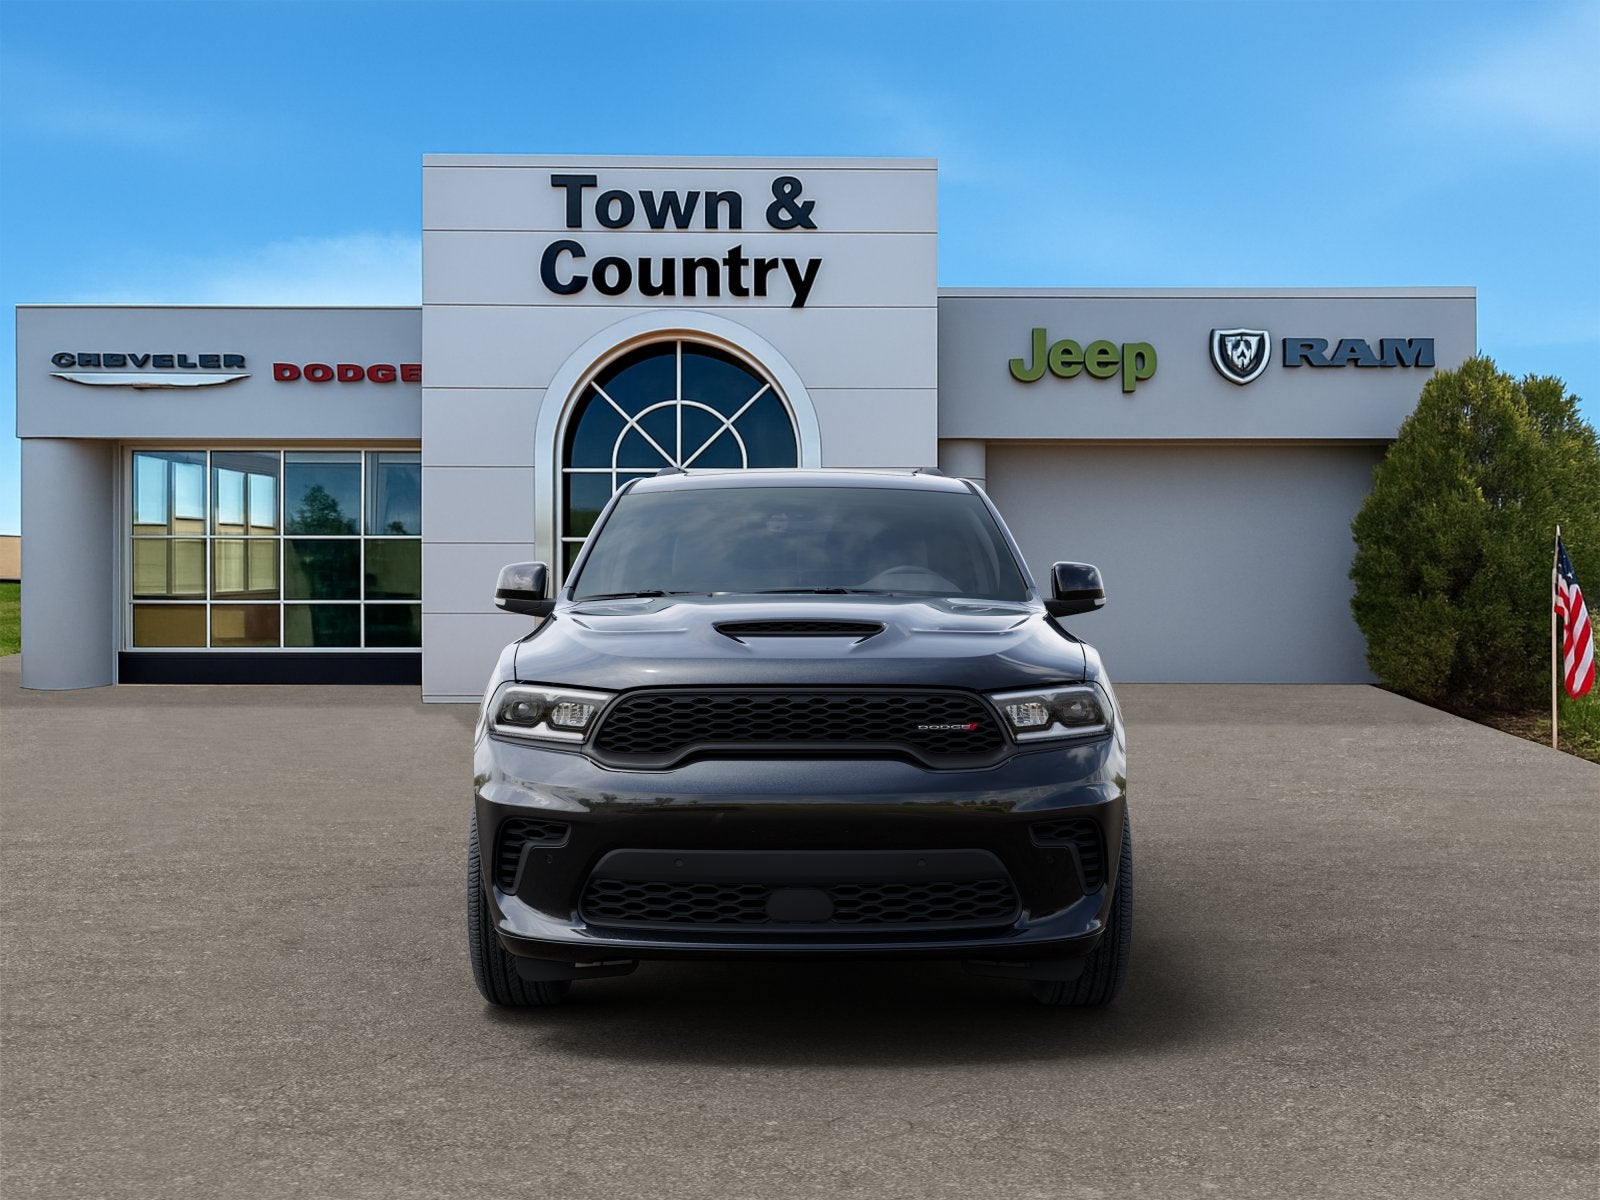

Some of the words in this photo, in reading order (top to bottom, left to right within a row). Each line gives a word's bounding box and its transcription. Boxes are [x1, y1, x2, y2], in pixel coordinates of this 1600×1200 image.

[551, 174, 742, 229] Town
[765, 176, 818, 230] &
[540, 239, 822, 308] Country
[273, 363, 421, 382] DODGE
[1009, 328, 1157, 392] Jeep
[1282, 337, 1435, 368] RAM
